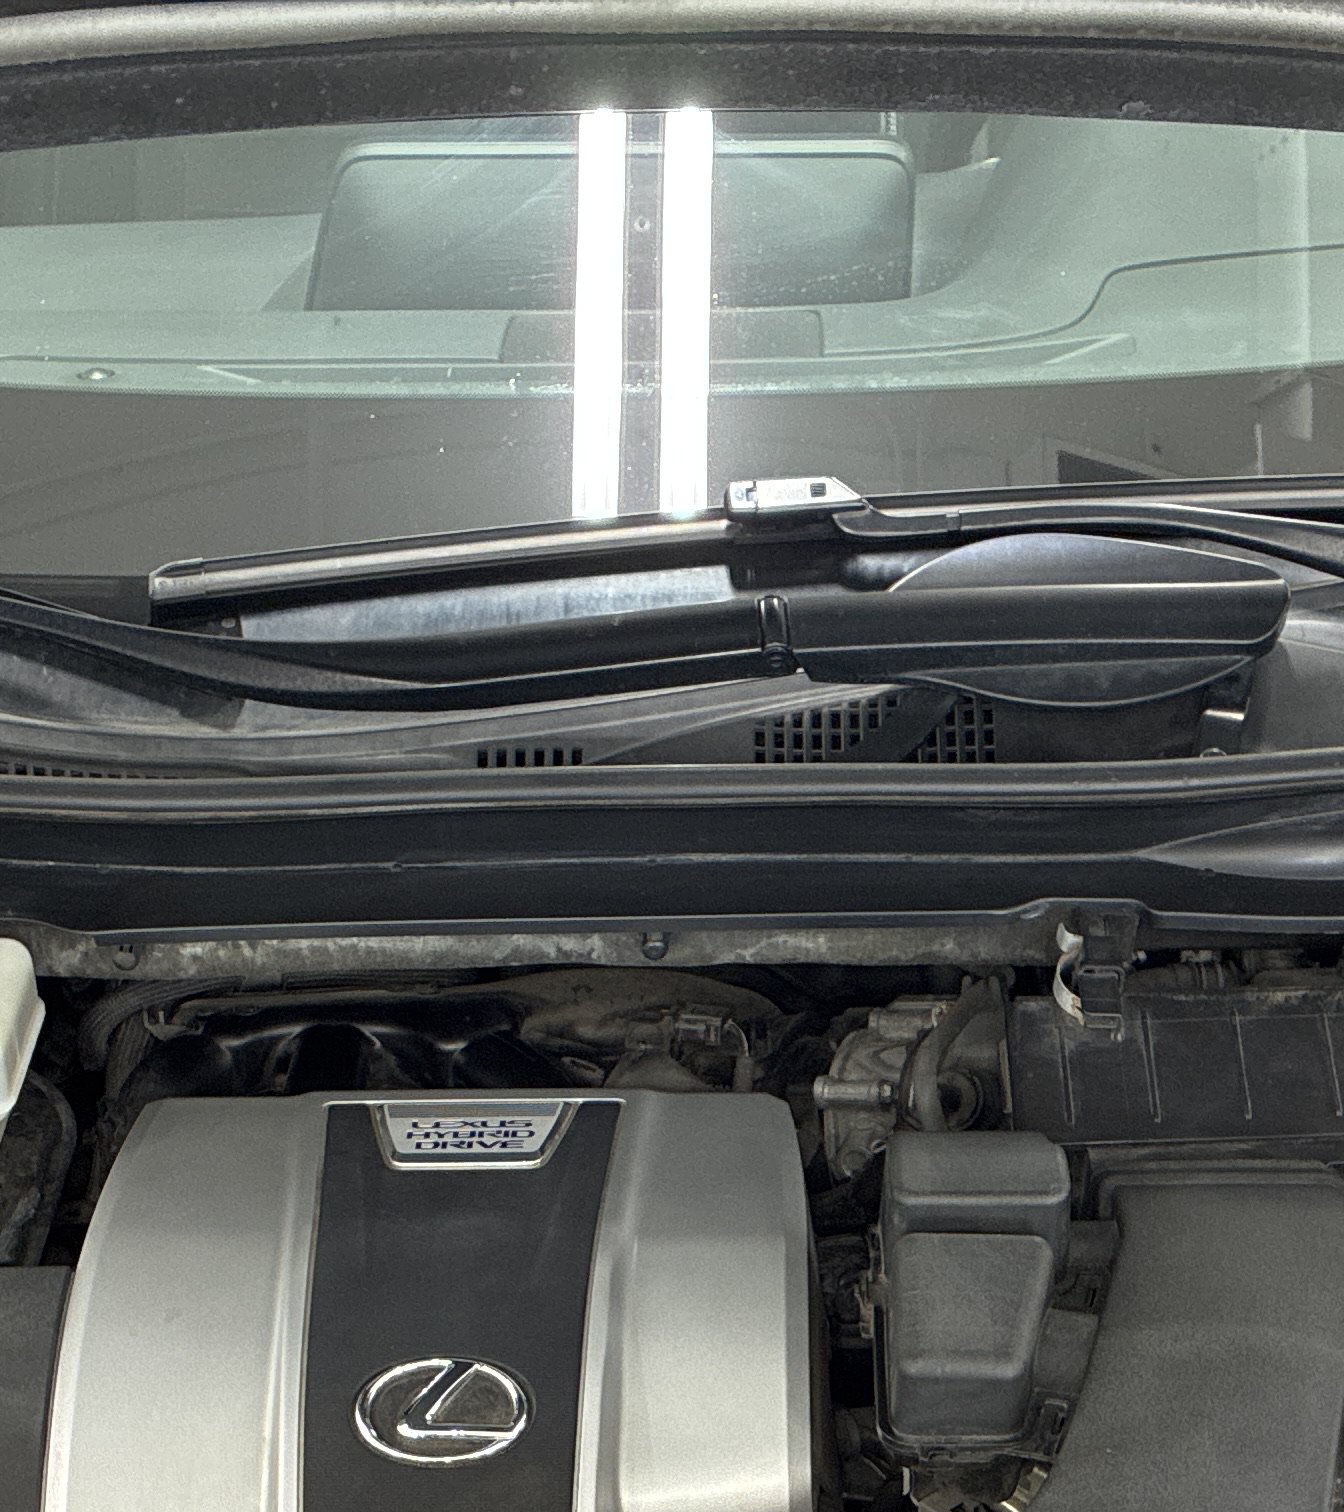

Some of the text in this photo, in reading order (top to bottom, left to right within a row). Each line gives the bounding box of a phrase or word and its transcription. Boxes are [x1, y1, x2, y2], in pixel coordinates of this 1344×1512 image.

[412, 1120, 532, 1128] LEXUS
[407, 1130, 535, 1139] HYBRID
[415, 1140, 524, 1149] DRIVE
